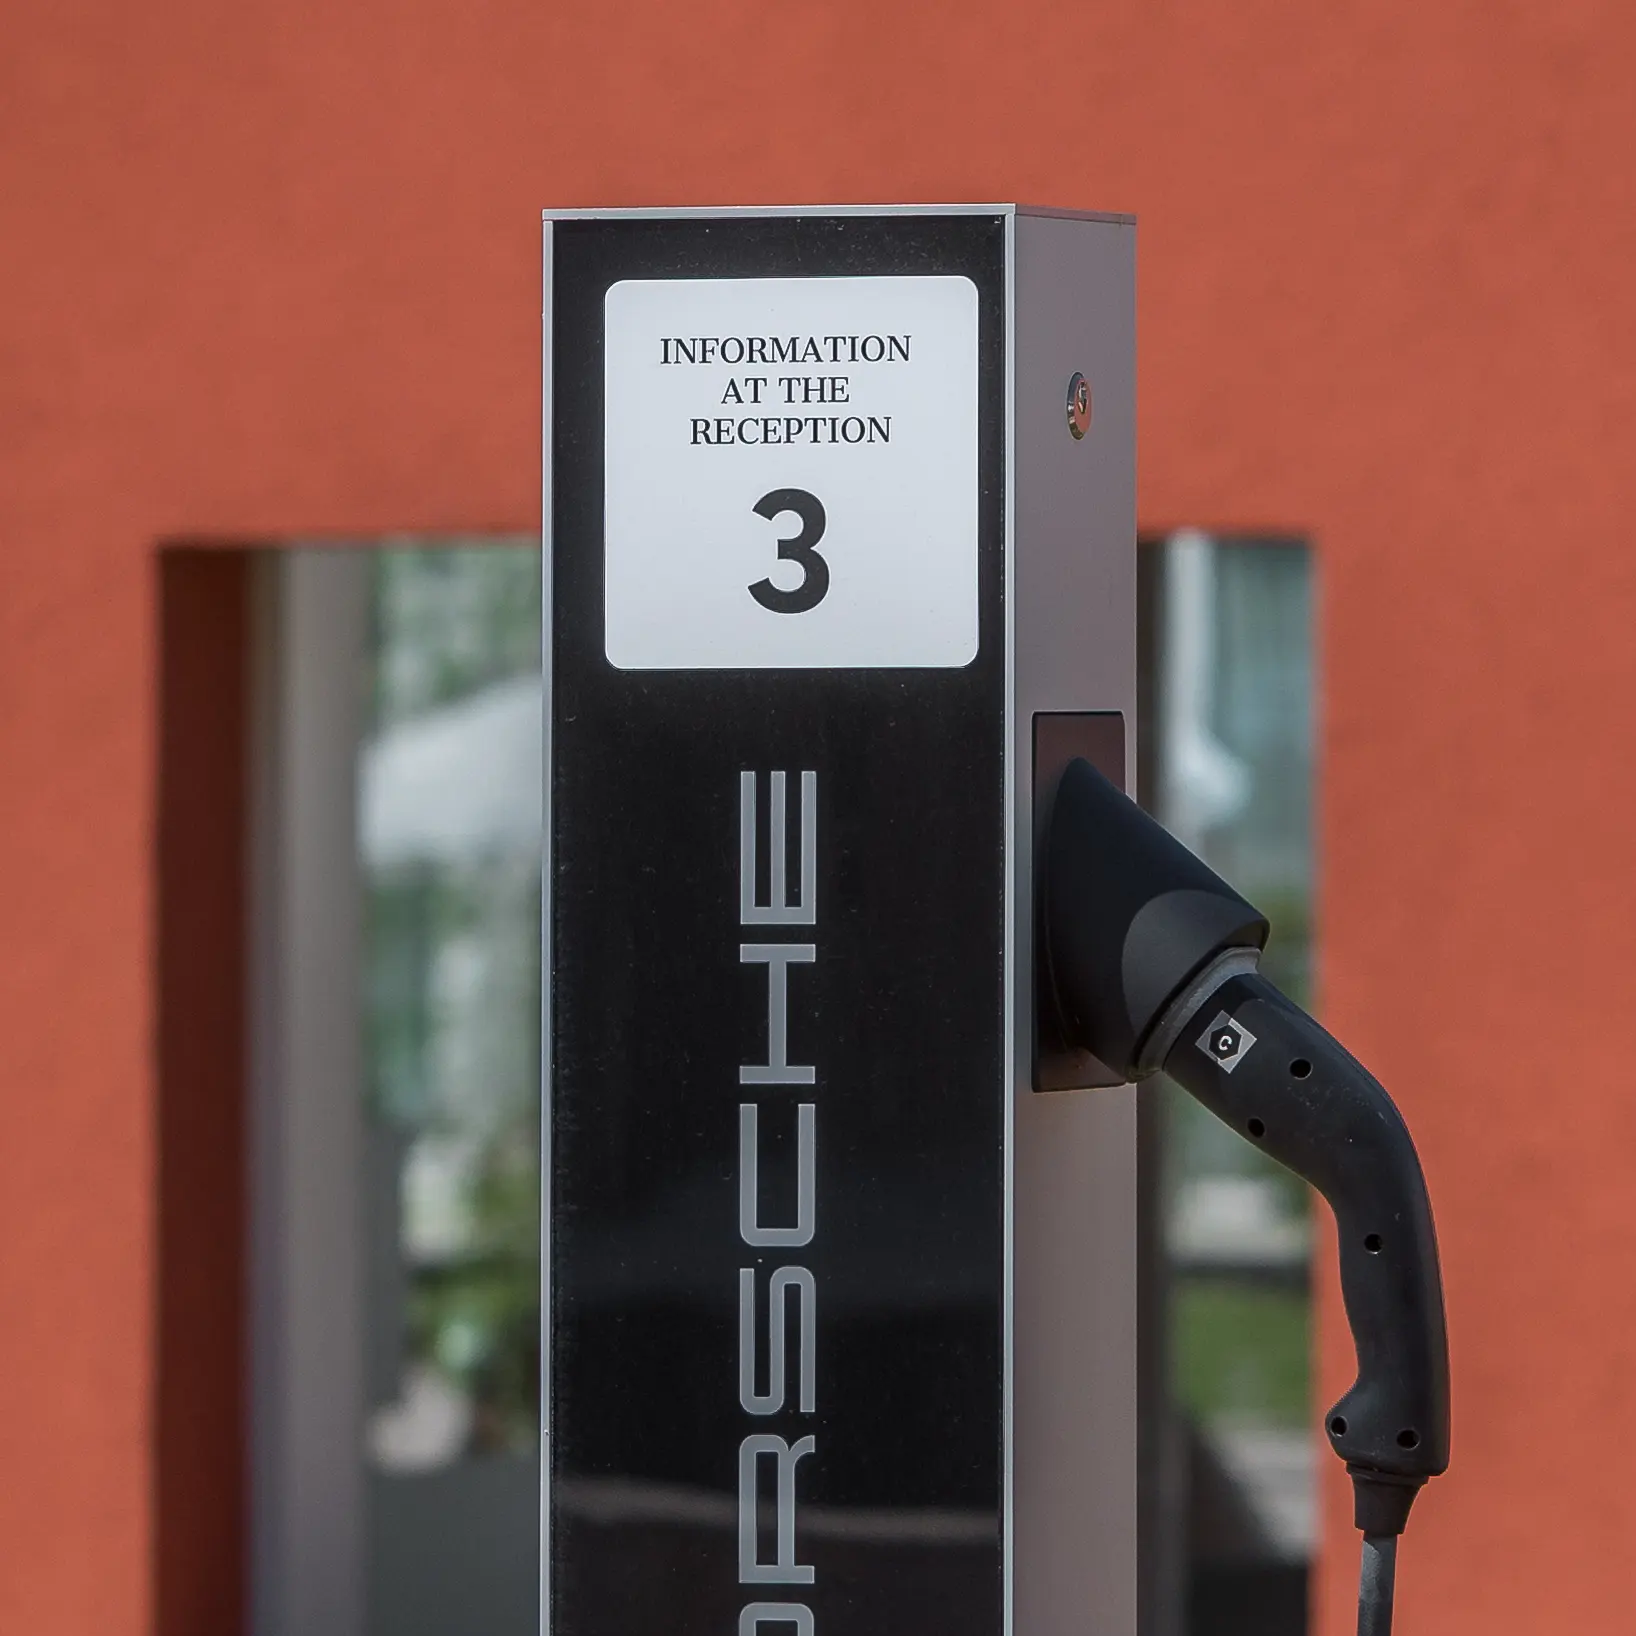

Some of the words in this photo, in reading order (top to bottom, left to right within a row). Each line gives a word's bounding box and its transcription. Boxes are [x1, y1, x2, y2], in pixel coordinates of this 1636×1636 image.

[659, 335, 912, 366] INFORMATION
[720, 377, 768, 405] AT
[778, 376, 850, 404] THE
[690, 416, 892, 446] RECEPTION
[747, 488, 830, 615] 3
